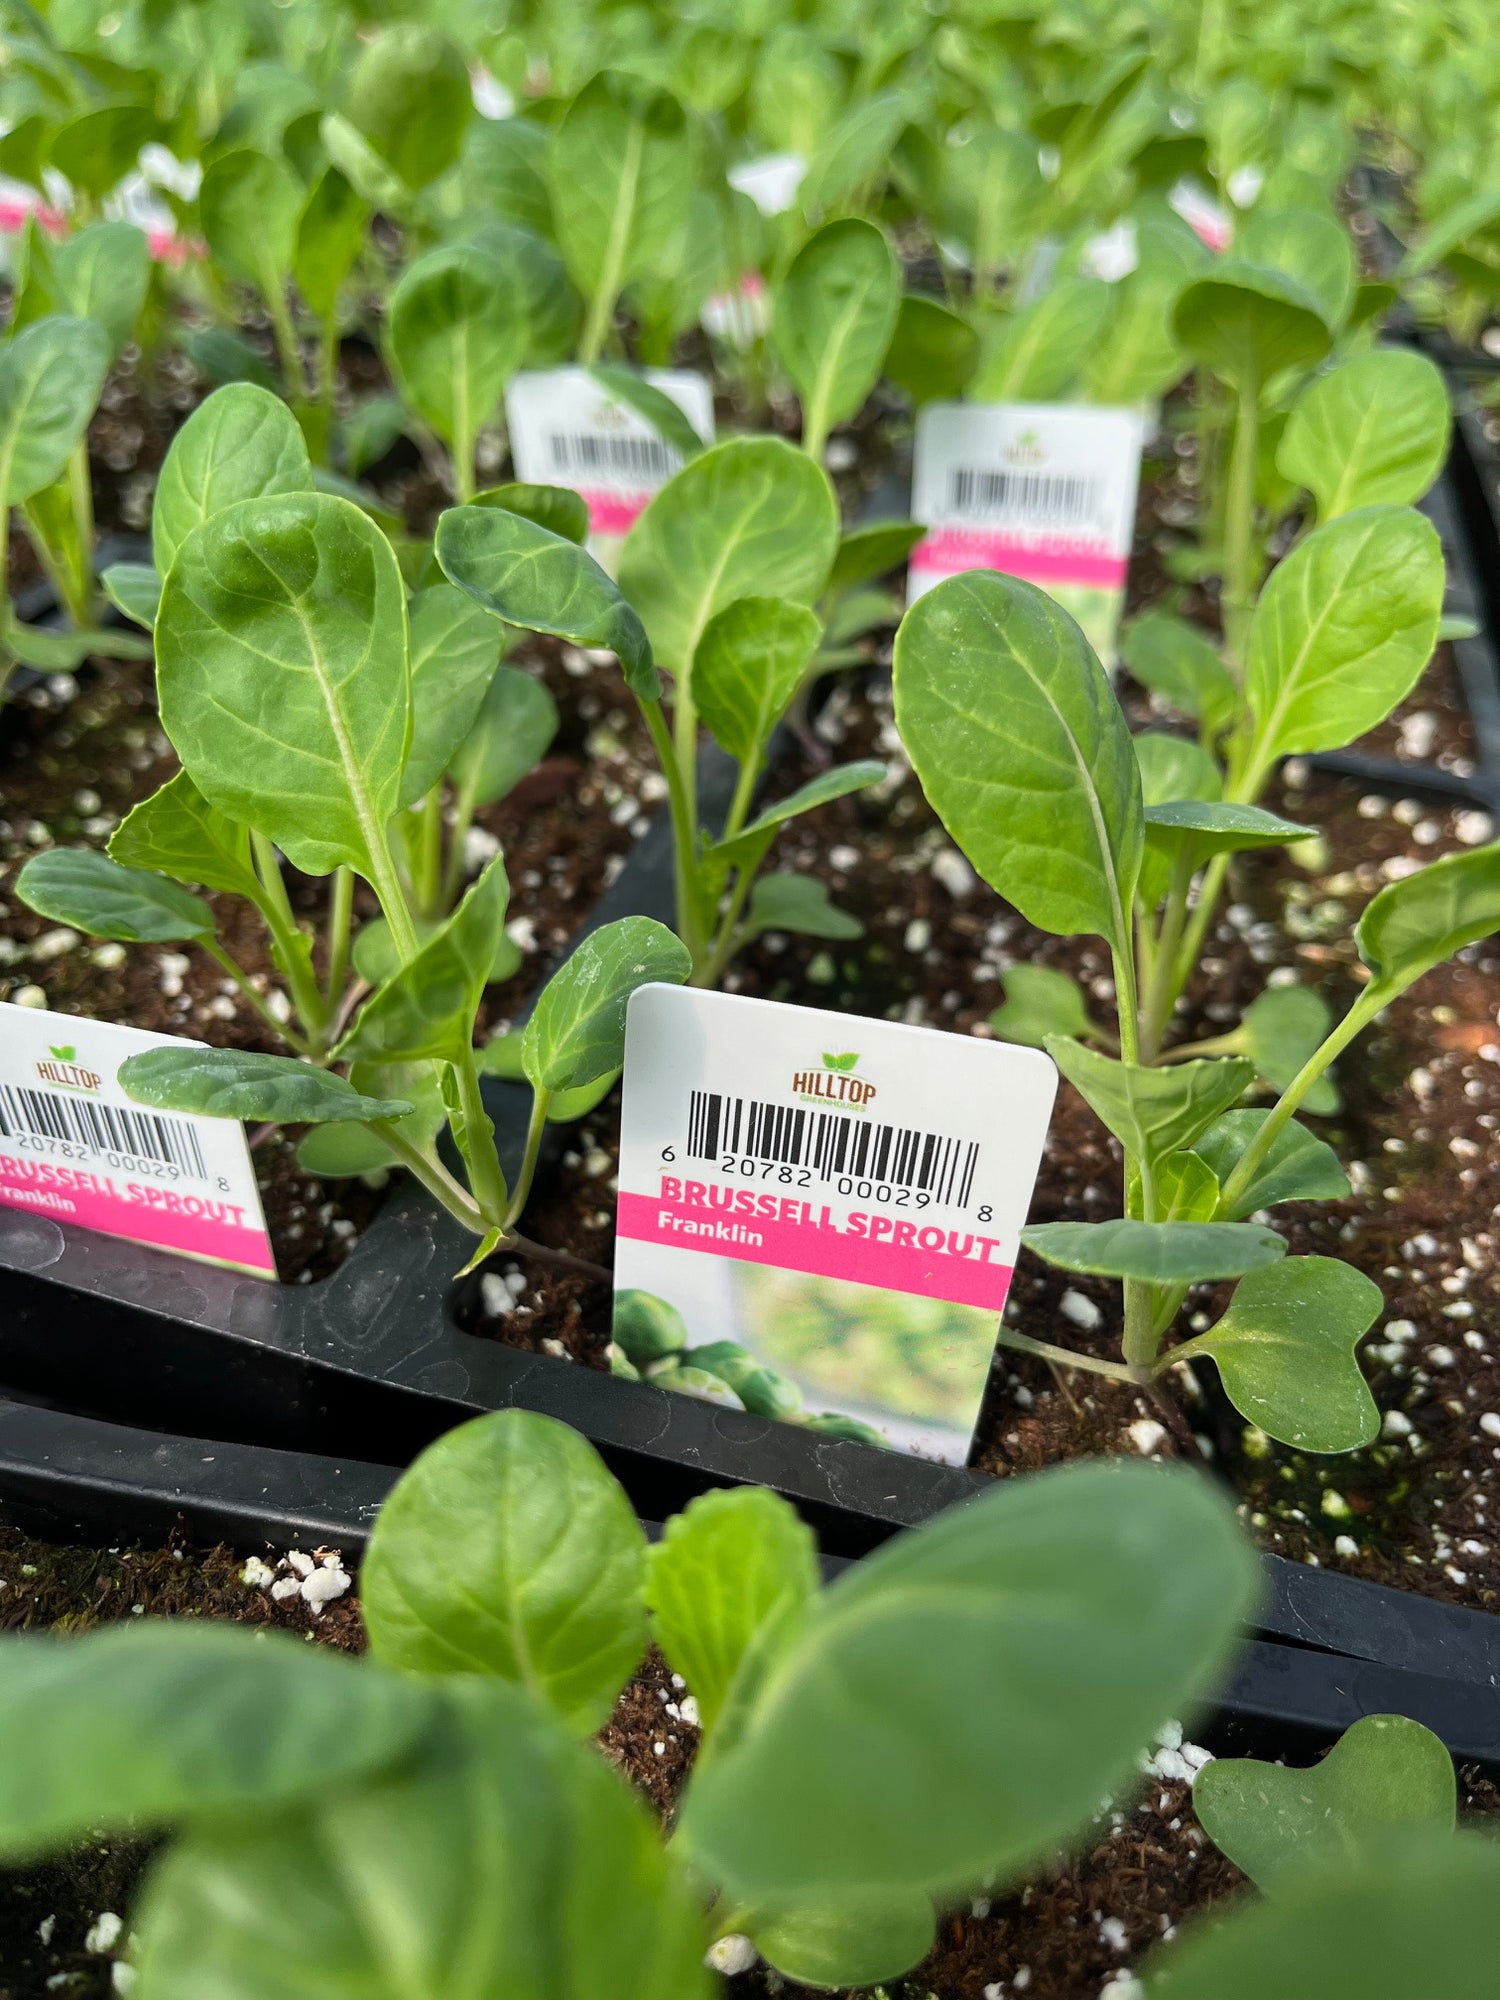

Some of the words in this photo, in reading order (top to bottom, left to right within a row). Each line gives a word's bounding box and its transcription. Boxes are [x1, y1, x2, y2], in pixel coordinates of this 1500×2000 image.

[36, 1062, 102, 1090] HILLTOP
[792, 1072, 877, 1105] HILLTOP
[799, 1094, 867, 1112] GREENHOUSES
[17, 1132, 89, 1161] 20782
[107, 1152, 180, 1181] 00029
[217, 1176, 231, 1192] 8
[0, 1154, 123, 1199] RUSSELL
[126, 1182, 245, 1226] SPROUT
[0, 1183, 77, 1213] ranklin
[660, 1144, 676, 1162] 6
[721, 1155, 811, 1188] 20782
[838, 1177, 931, 1210] 00029
[977, 1204, 994, 1223] 8
[657, 1210, 764, 1248] Franklin
[660, 1175, 837, 1233] BRUSSELL
[845, 1211, 1000, 1263] SPROUT
